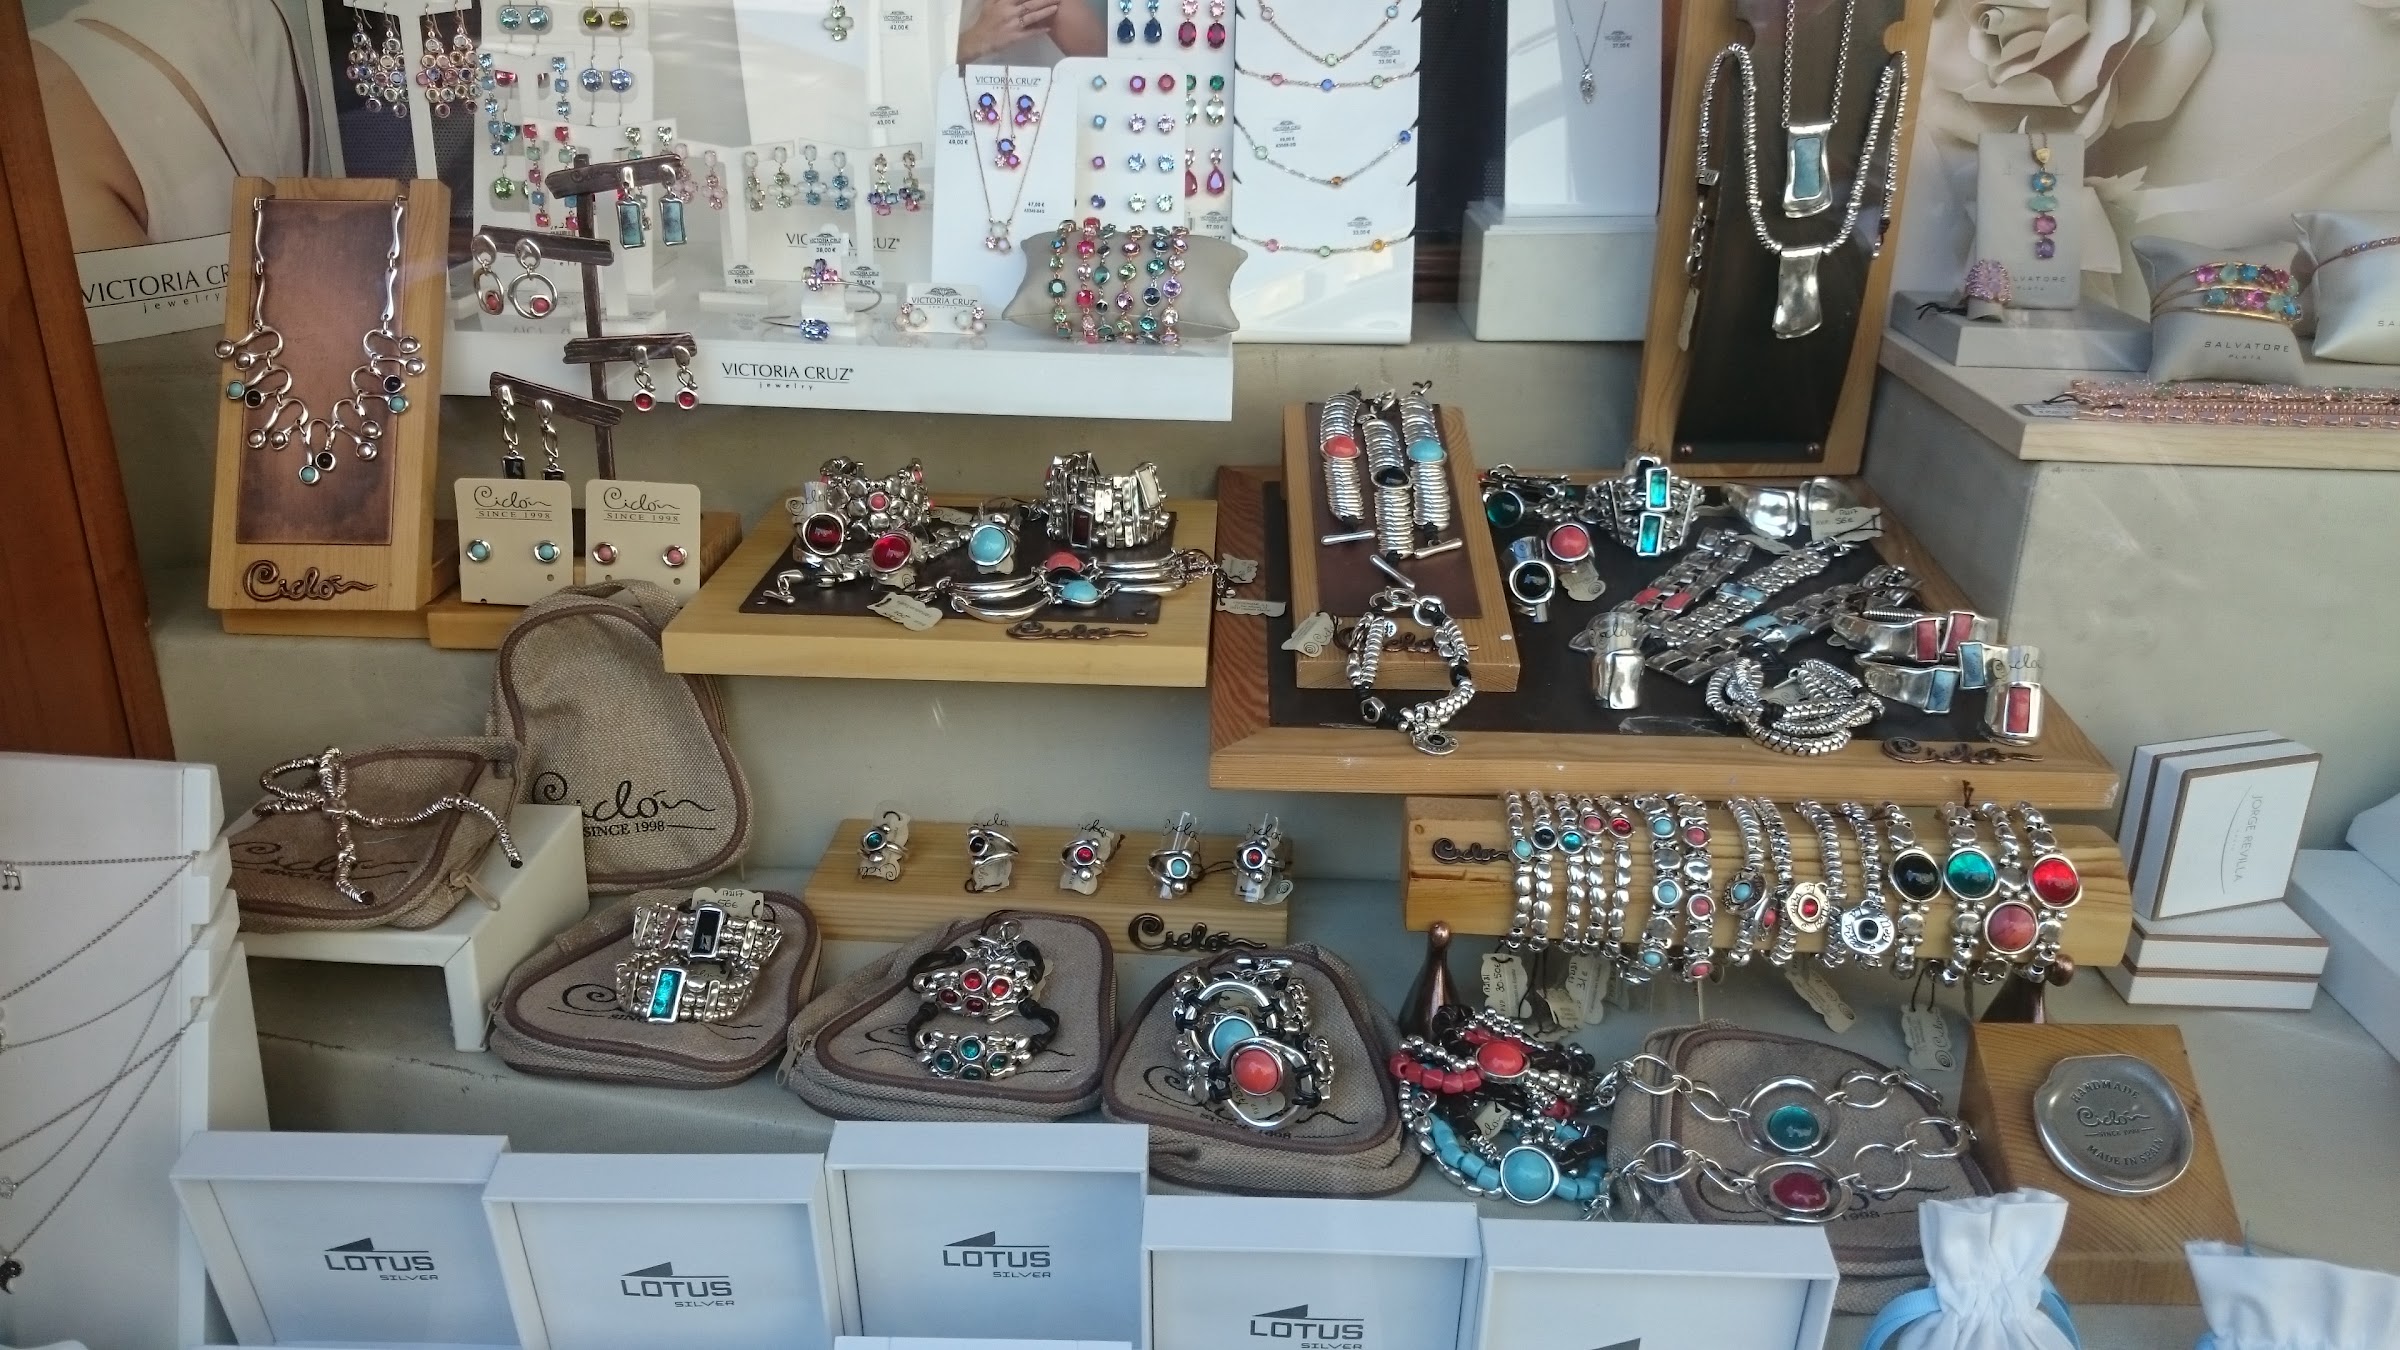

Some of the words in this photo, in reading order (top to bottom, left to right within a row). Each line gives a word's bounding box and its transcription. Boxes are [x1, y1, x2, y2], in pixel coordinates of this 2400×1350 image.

[975, 76, 1014, 85] VICTORIA
[82, 270, 200, 303] VICTORIA
[143, 292, 221, 314] jewelry
[911, 297, 950, 305] VICTORIA
[2204, 341, 2289, 353] SALVATORE
[721, 362, 800, 379] VICTORIA
[759, 381, 813, 391] jewelry
[473, 485, 552, 508] Ciclón
[603, 486, 681, 511] Ciclón
[478, 510, 517, 518] SINCE
[523, 511, 551, 519] 1998
[606, 512, 645, 520] SINCE
[652, 514, 679, 522] 1998
[243, 559, 378, 602] Ciclón
[2246, 795, 2264, 832] JORGE
[583, 823, 631, 838] SINCE
[635, 821, 665, 833] 1998
[2233, 835, 2254, 882] REVILLA
[2070, 1080, 2140, 1103] HANDMADE
[2076, 1105, 2151, 1127] Ciclón
[2086, 1144, 2120, 1165] MADE
[2123, 1157, 2138, 1165] IN
[2139, 1137, 2164, 1163] SPAIN
[324, 1254, 435, 1271] LOTUS
[943, 1250, 1051, 1268] LOTUS
[621, 1279, 733, 1297] LOTUS
[1250, 1320, 1364, 1340] LOTUS
